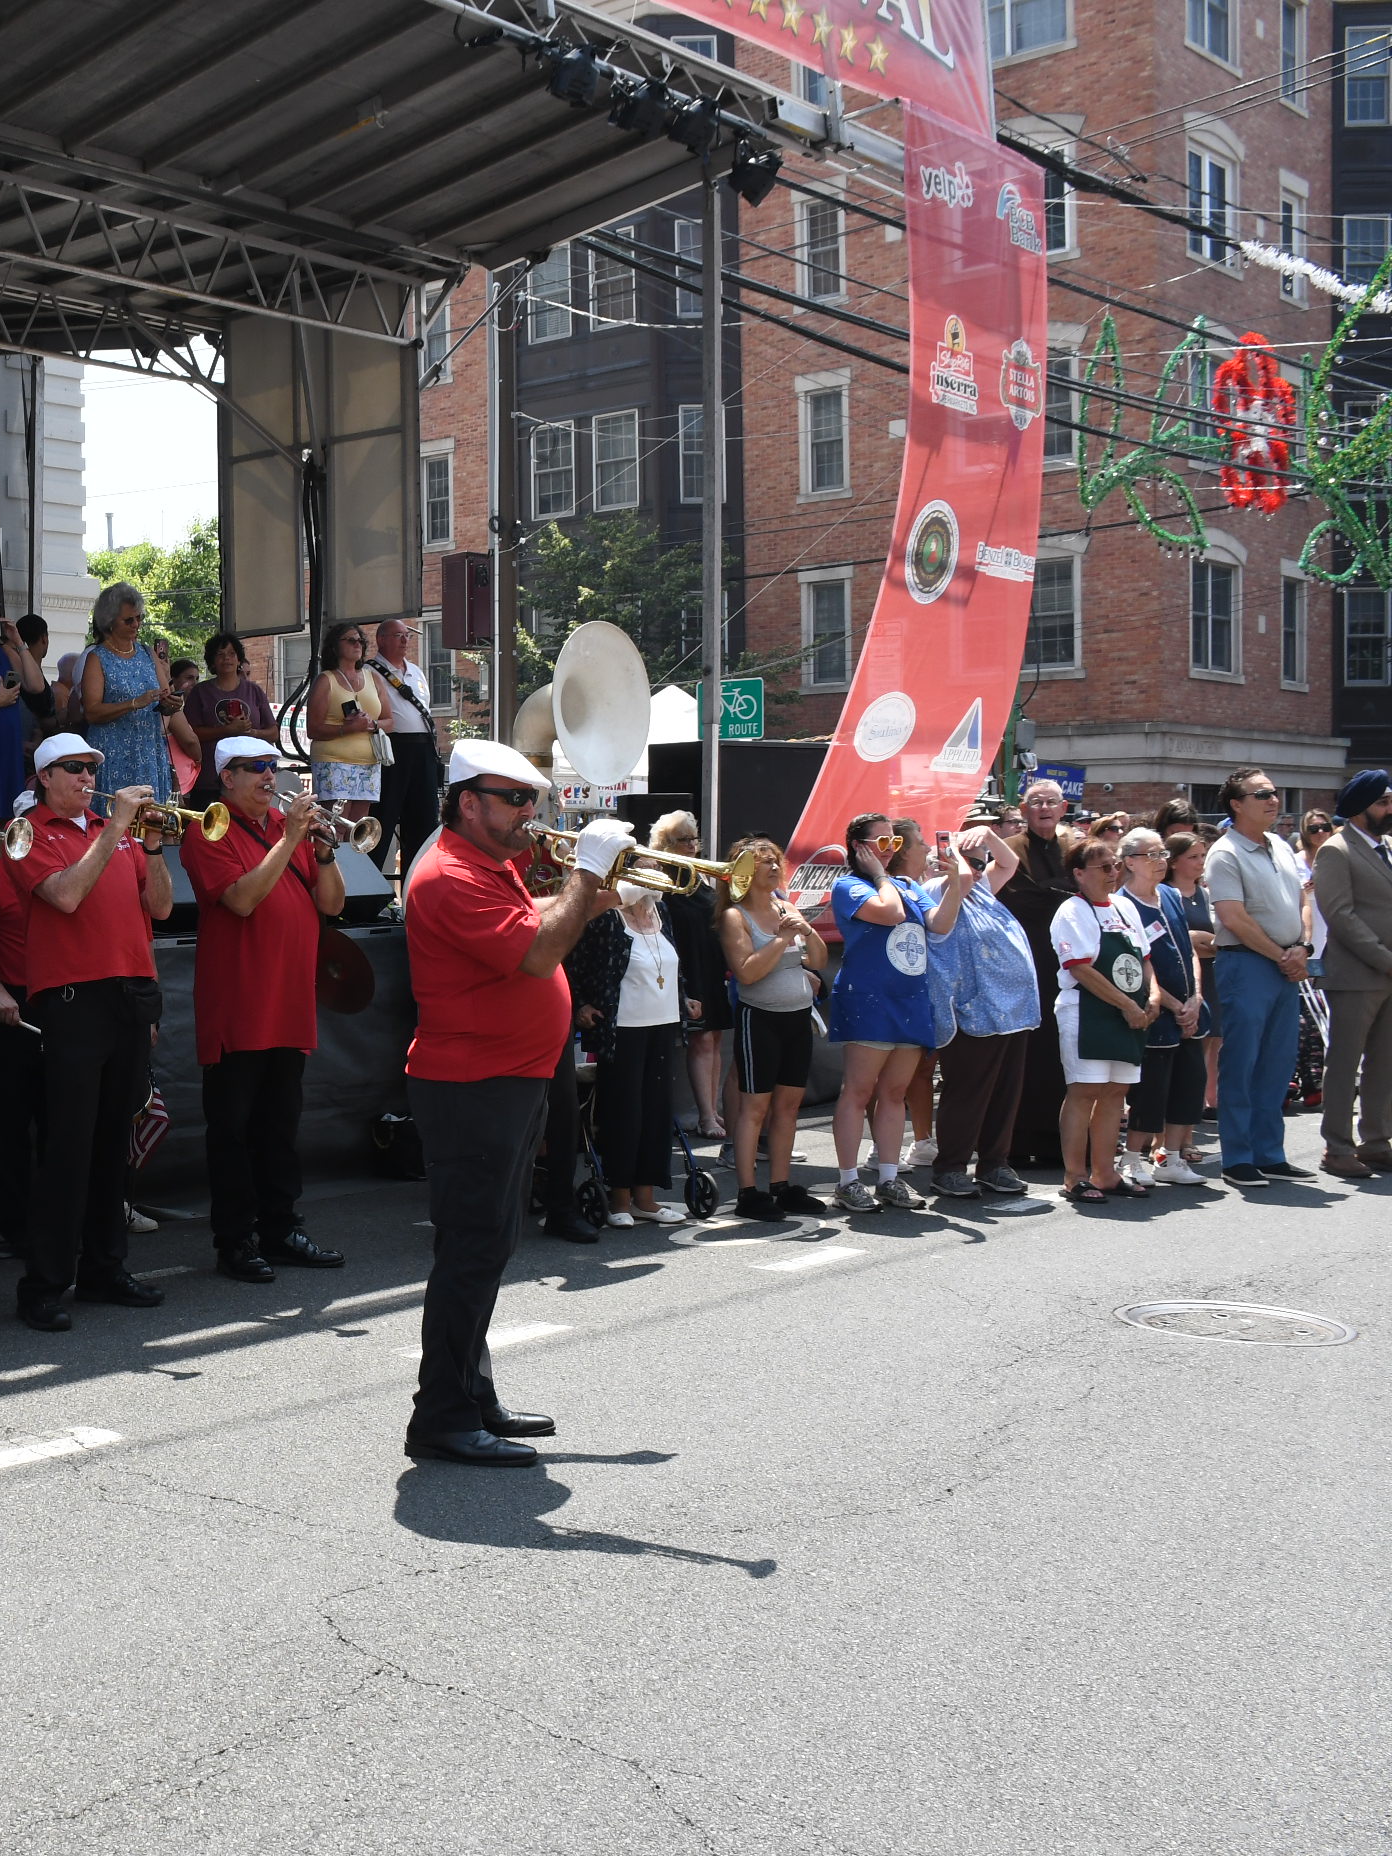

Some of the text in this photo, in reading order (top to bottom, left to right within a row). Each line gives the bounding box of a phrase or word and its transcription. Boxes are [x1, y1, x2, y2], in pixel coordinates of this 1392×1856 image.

[921, 169, 956, 205] yelp
[1010, 206, 1034, 231] BCB
[1011, 226, 1042, 255] Bank
[1009, 368, 1034, 388] STELLA
[1009, 383, 1035, 403] ARTOIS
[728, 723, 758, 735] ROUTE
[1061, 780, 1084, 796] CAKE
